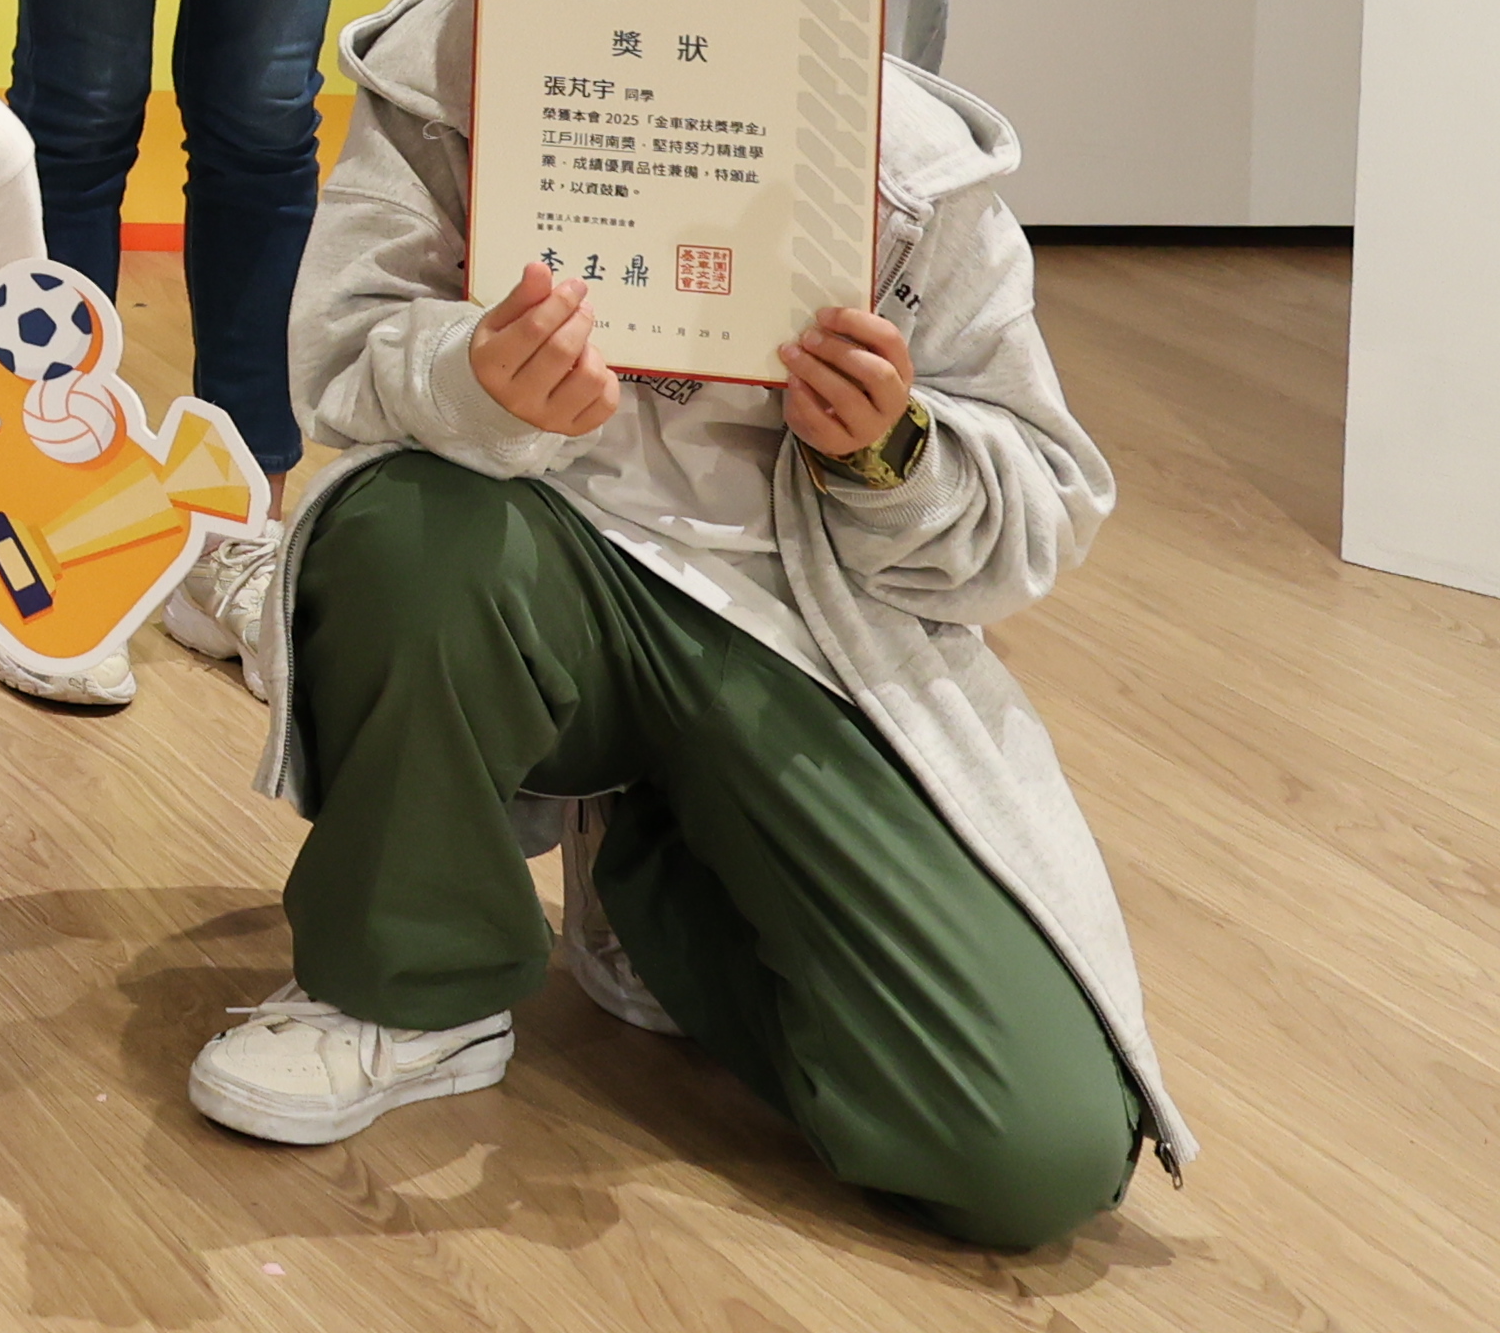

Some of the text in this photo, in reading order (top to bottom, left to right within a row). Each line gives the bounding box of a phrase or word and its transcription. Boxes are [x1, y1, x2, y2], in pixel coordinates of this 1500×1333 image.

[544, 75, 654, 103] 張芃宇 同學
